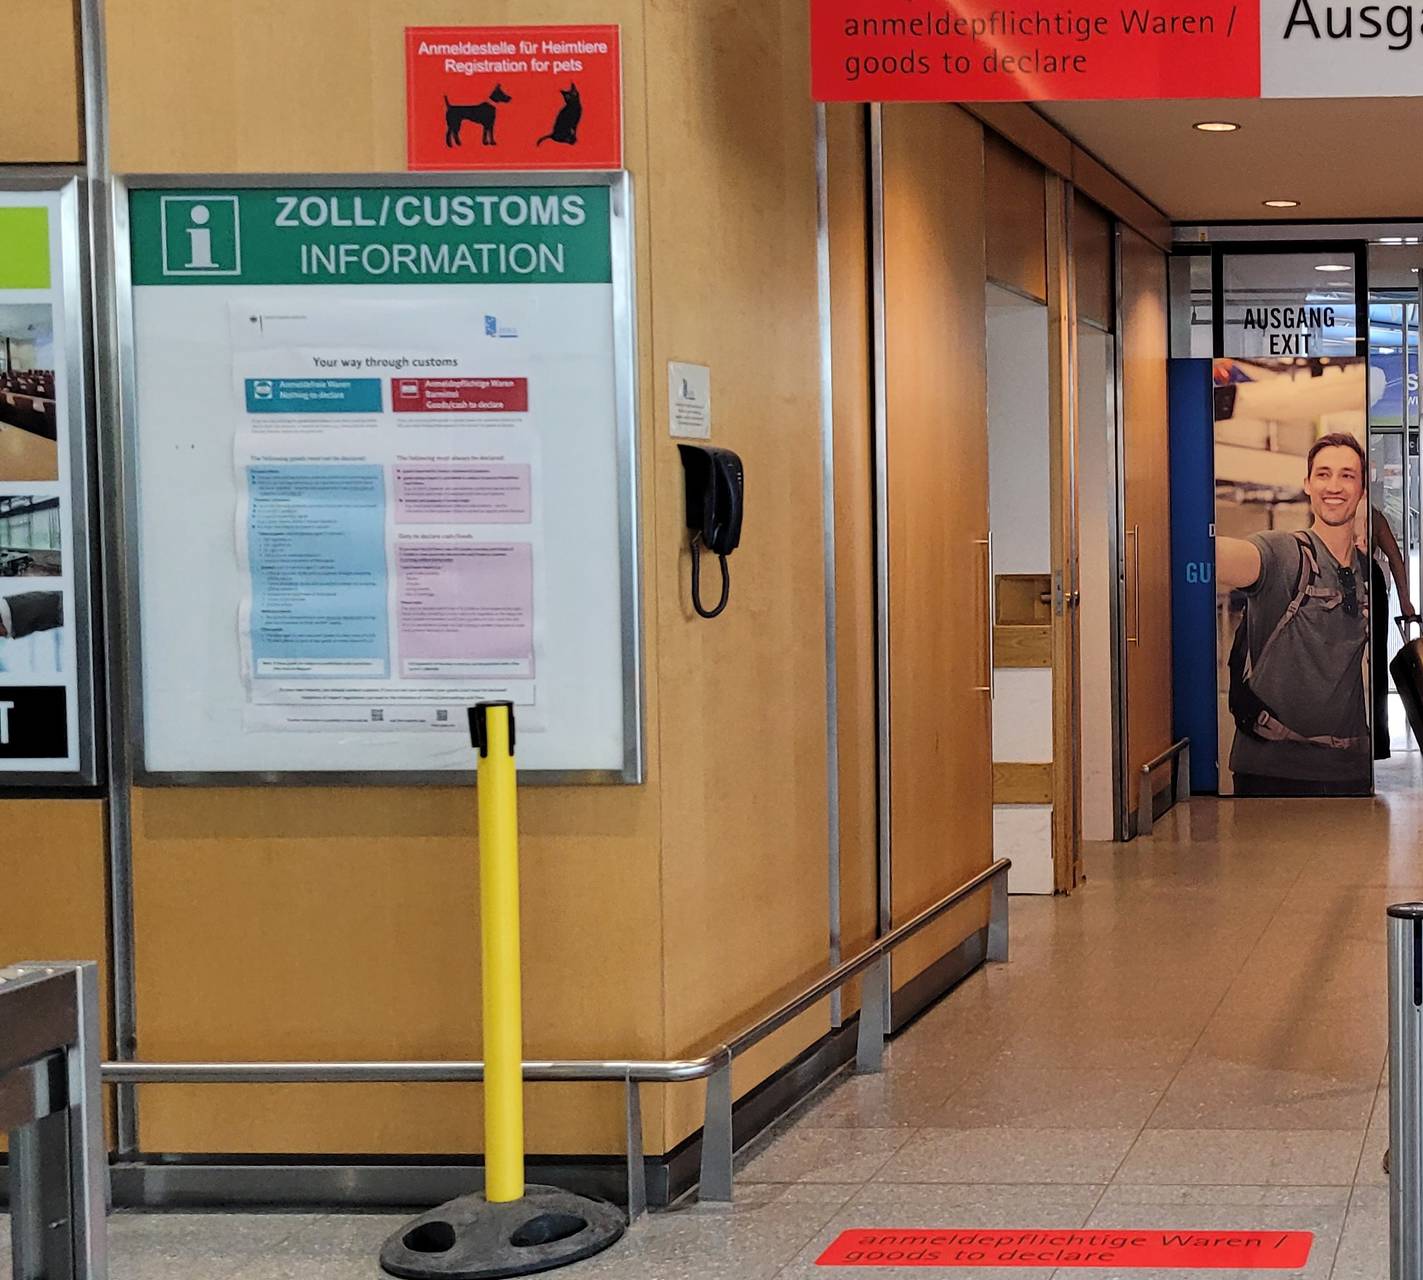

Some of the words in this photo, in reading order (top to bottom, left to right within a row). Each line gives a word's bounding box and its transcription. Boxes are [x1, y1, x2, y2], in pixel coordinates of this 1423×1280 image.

[844, 10, 1108, 41] anmeldepflichtige
[1120, 9, 1215, 36] Waren
[1226, 6, 1237, 37] /
[418, 41, 515, 56] Anmeldestelle
[519, 40, 537, 55] für
[541, 40, 608, 54] Heimtiere
[445, 58, 527, 75] Registration
[530, 58, 549, 72] for
[552, 60, 583, 74] pets
[844, 48, 930, 80] goods
[943, 52, 970, 74] to
[983, 48, 1087, 74] declare
[275, 195, 585, 227] ZOLL/CUSTOMS
[301, 243, 564, 274] INFORMATION
[1244, 307, 1335, 329] AUSGANG
[1269, 334, 1311, 355] EXIT
[312, 357, 337, 367] Your
[341, 359, 362, 369] way
[365, 357, 409, 369] through
[412, 358, 458, 367] customs
[858, 1233, 1147, 1249] anmeldepflichtige
[1161, 1234, 1263, 1247] Waren
[843, 1248, 939, 1263] goods
[953, 1249, 983, 1262] to
[997, 1248, 1116, 1262] declare
